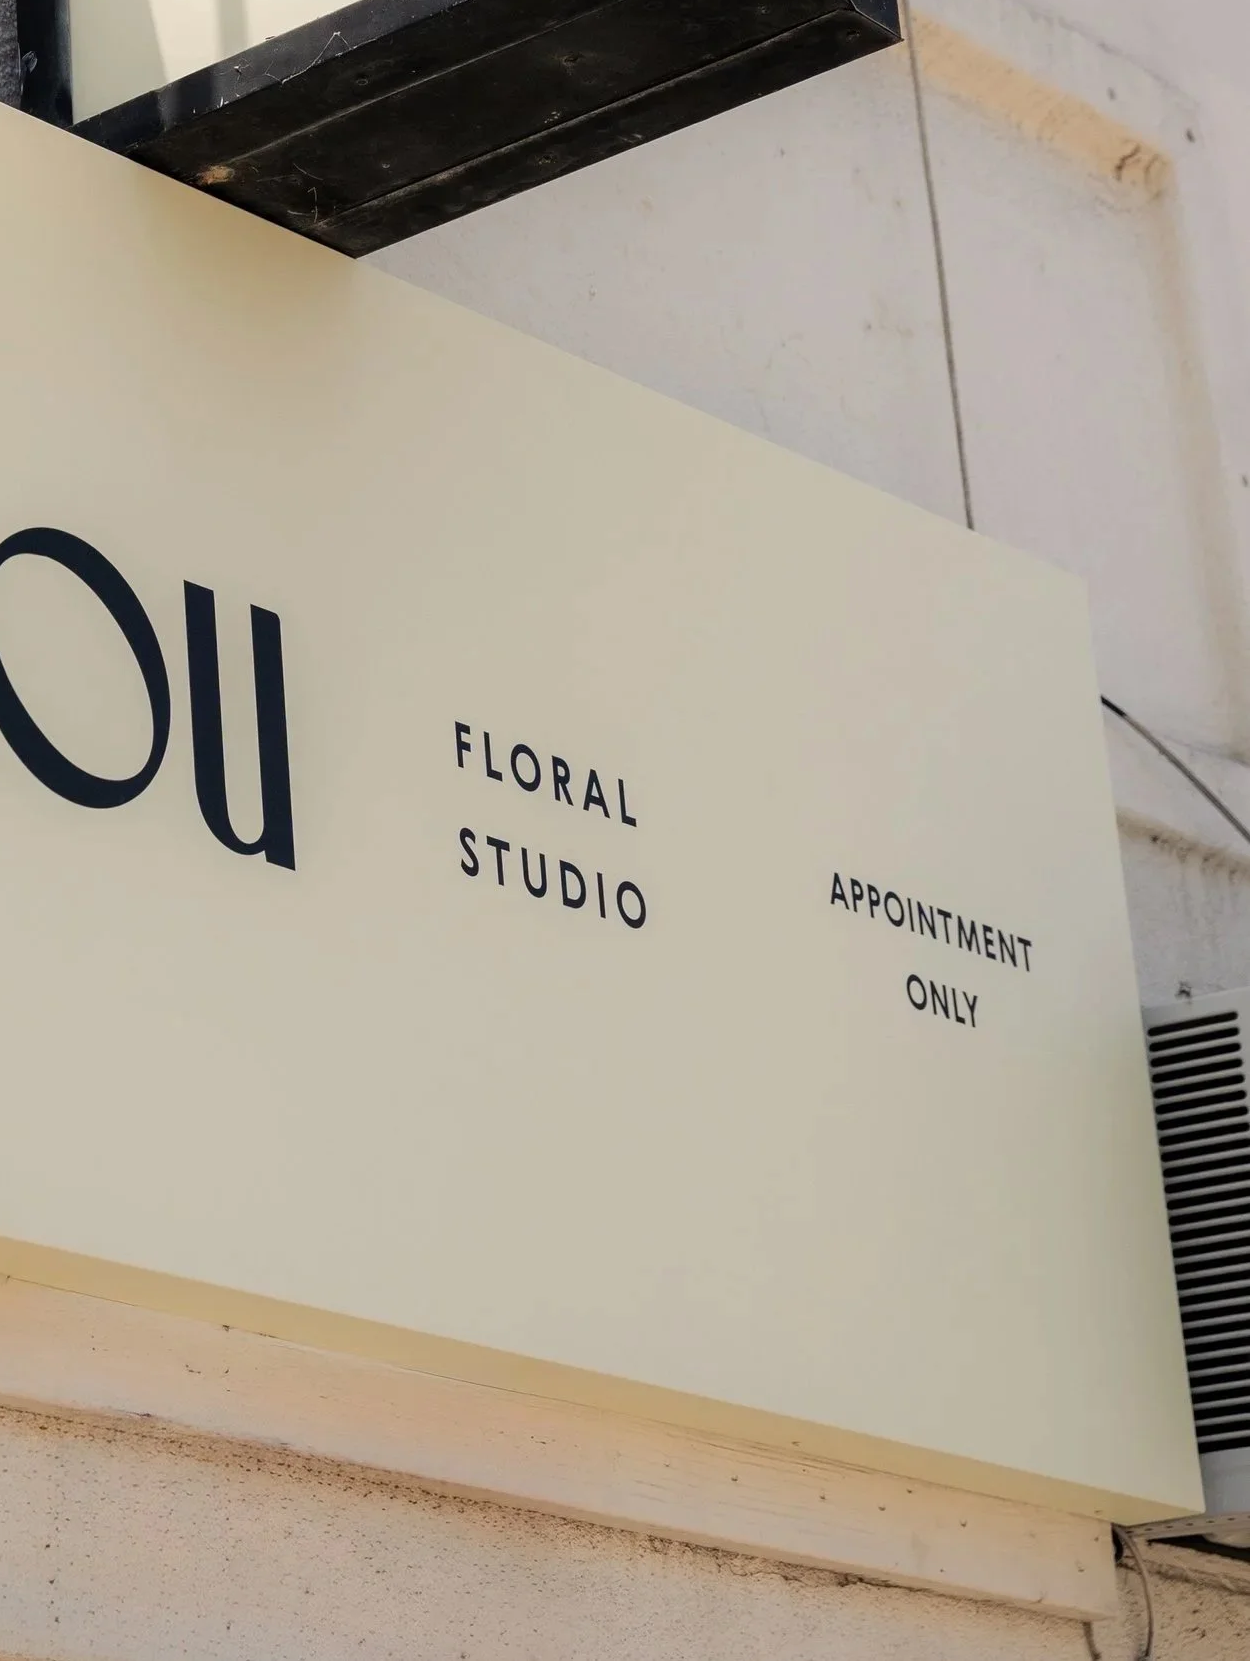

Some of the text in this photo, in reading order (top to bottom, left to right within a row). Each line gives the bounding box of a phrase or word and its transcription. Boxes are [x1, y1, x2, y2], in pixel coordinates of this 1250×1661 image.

[453, 718, 639, 829] FLORAL
[457, 825, 649, 931] STUDIO
[828, 870, 1034, 974] APPOINTMENT
[904, 972, 980, 1030] ONLY
